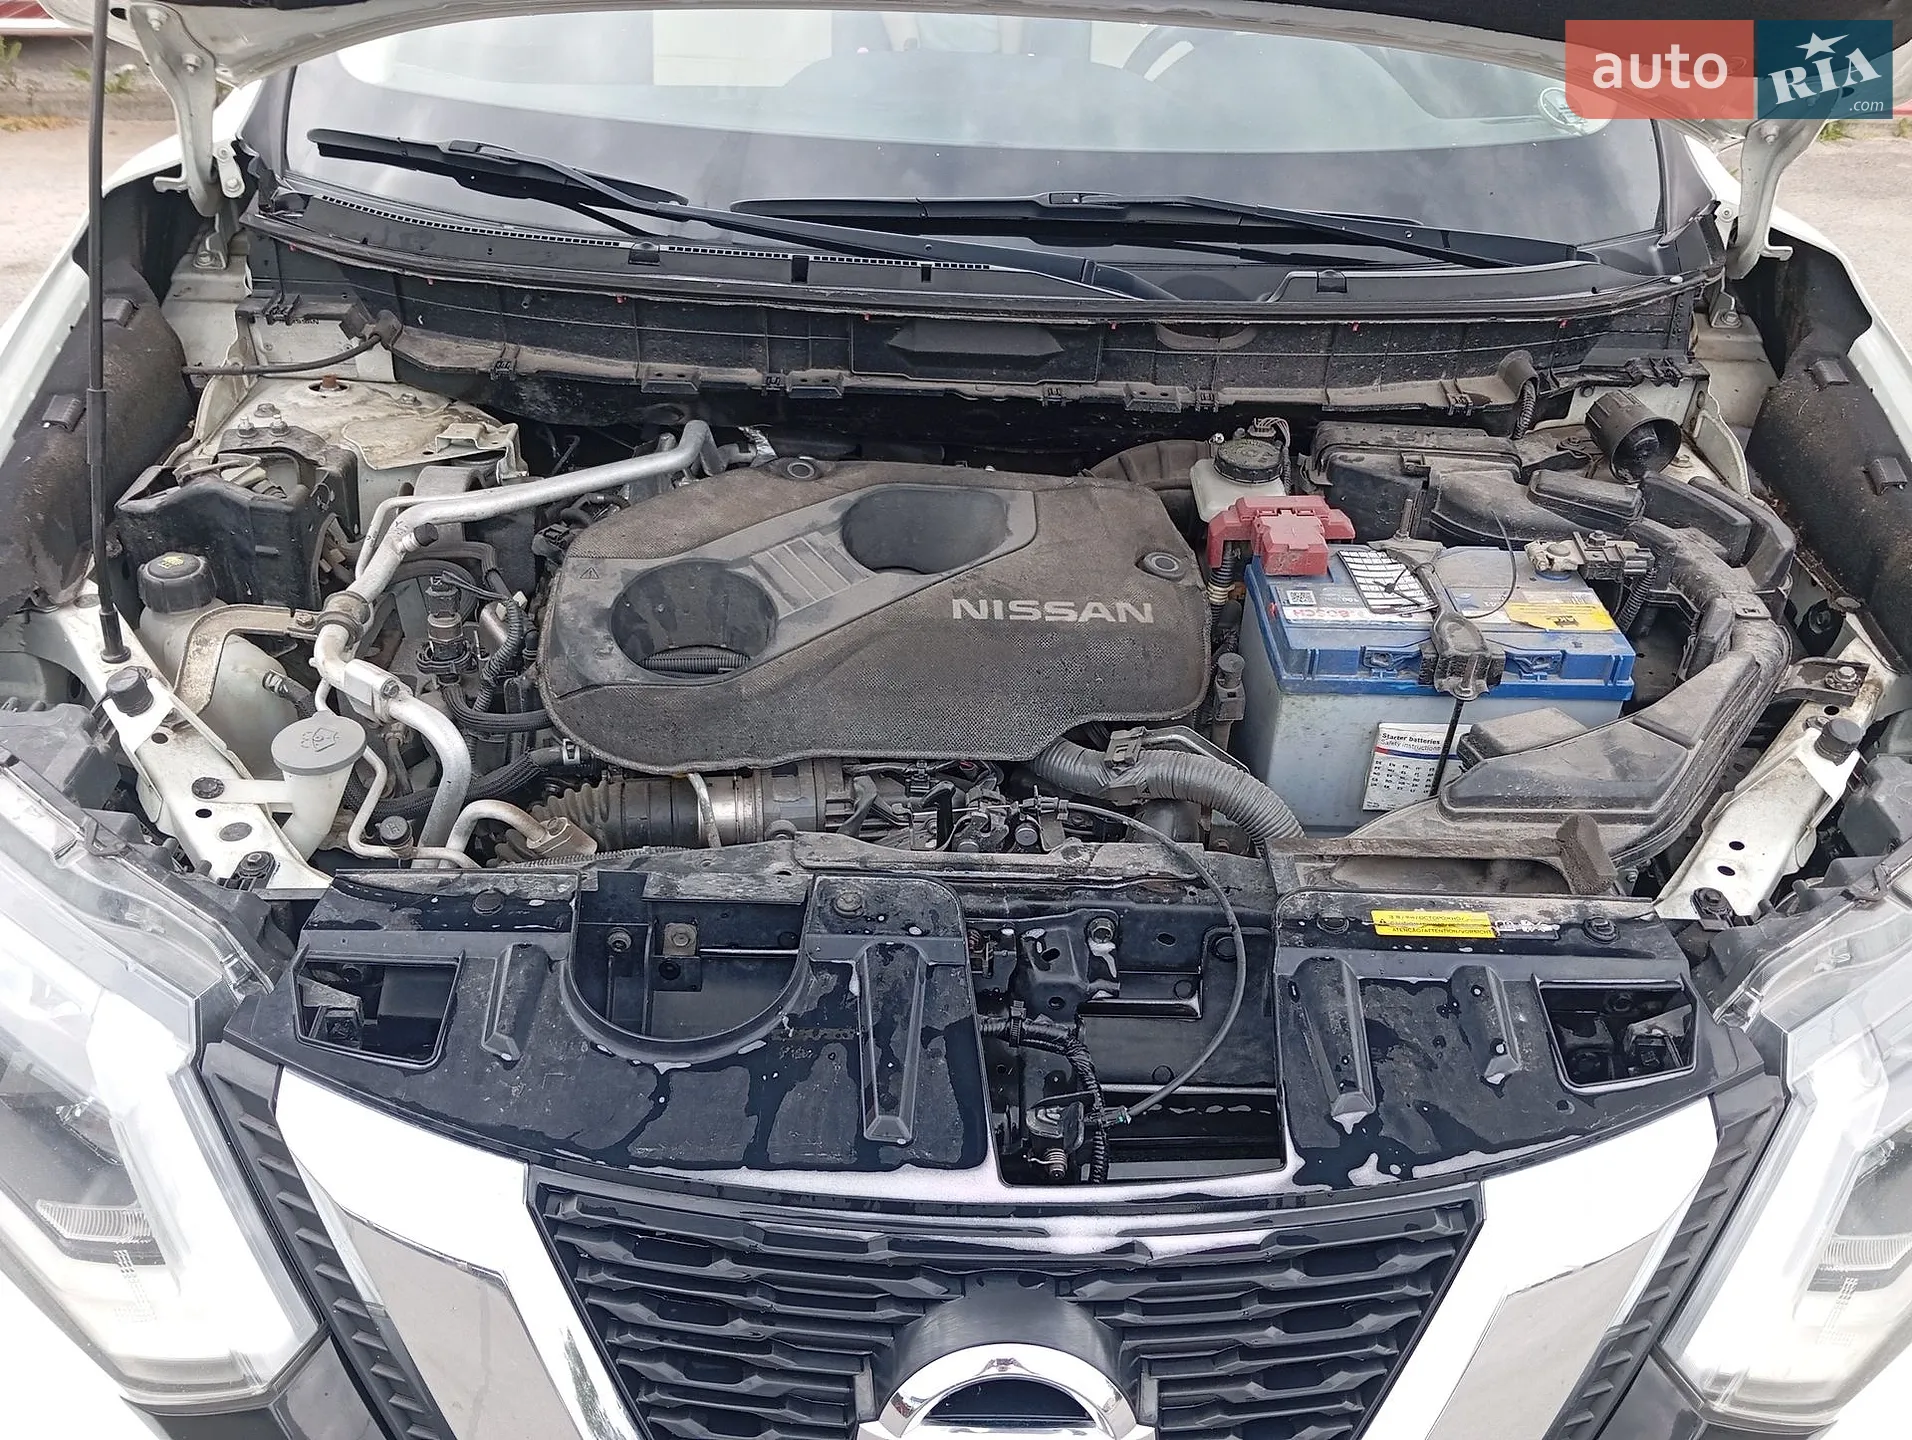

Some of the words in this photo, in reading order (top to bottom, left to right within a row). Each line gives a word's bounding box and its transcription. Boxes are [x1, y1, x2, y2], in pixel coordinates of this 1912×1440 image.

[951, 598, 1154, 624] NISSAN
[1382, 733, 1408, 741] Starter
[1408, 736, 1441, 745] batteries
